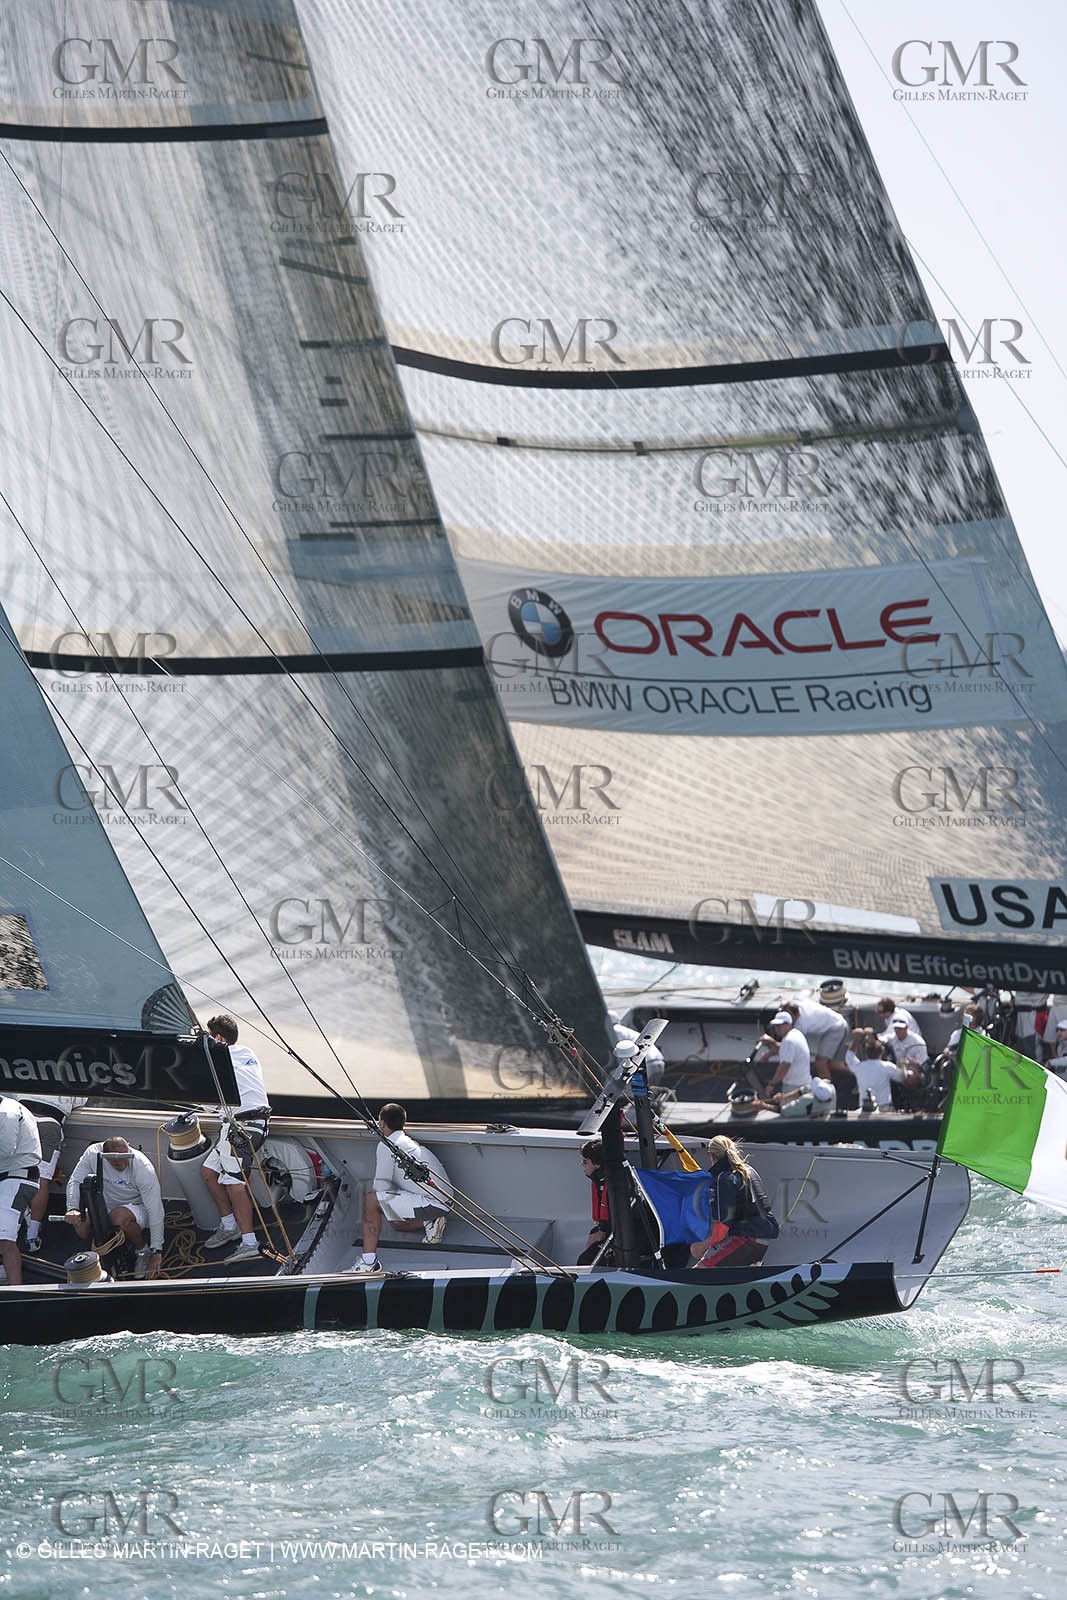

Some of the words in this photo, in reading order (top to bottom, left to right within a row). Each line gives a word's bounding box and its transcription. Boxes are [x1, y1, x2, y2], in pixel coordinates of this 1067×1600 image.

[594, 598, 941, 656] ORACLE
[548, 677, 632, 711] BMW
[643, 685, 800, 714] ORACLE
[805, 680, 932, 713] Racing
[940, 883, 1067, 929] USA
[613, 929, 674, 954] SLAM
[832, 949, 900, 974] BMW
[905, 953, 1067, 988] EfficientDyn
